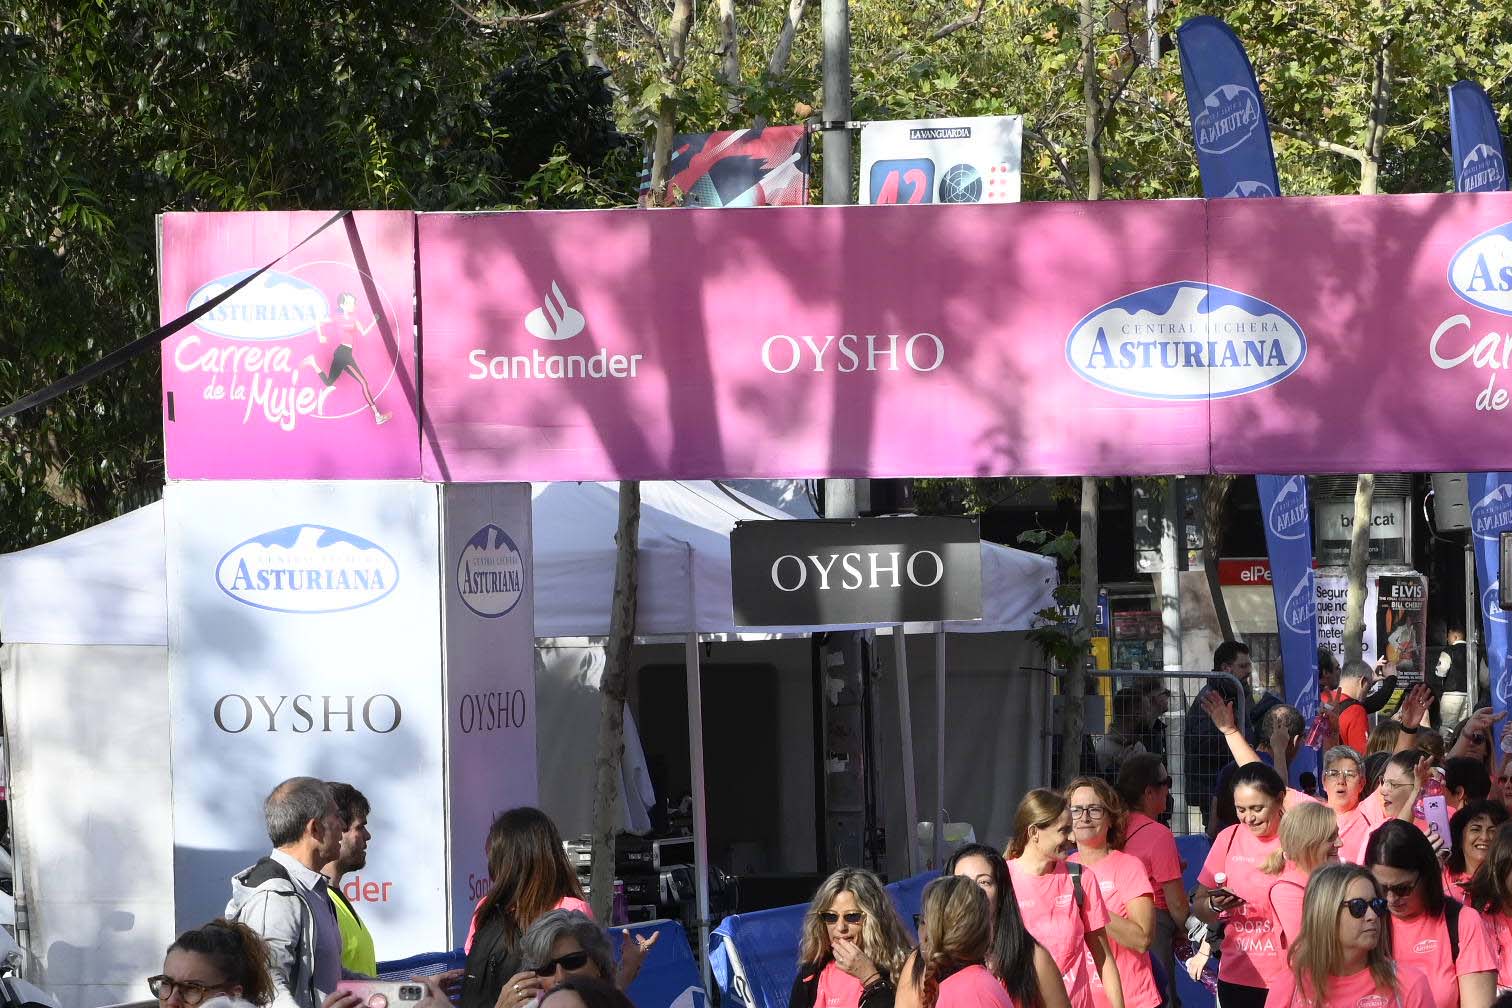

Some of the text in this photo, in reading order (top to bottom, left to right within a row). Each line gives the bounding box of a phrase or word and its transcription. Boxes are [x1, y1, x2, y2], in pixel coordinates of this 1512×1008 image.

[1086, 326, 1289, 370] ASTURIANA
[1121, 323, 1193, 336] CENTRAL
[174, 335, 293, 373] Carrera
[468, 346, 644, 380] Santander
[761, 333, 945, 374] OYSHO
[203, 370, 337, 431] de la Mujer
[1475, 372, 1511, 412] de
[230, 557, 385, 592] ASTURIANA
[462, 559, 520, 595] ASTURIANA
[771, 550, 944, 592] OYSHO
[1391, 584, 1422, 599] ELVIS
[213, 693, 402, 734] OYSHO
[459, 689, 526, 734] OYSHO
